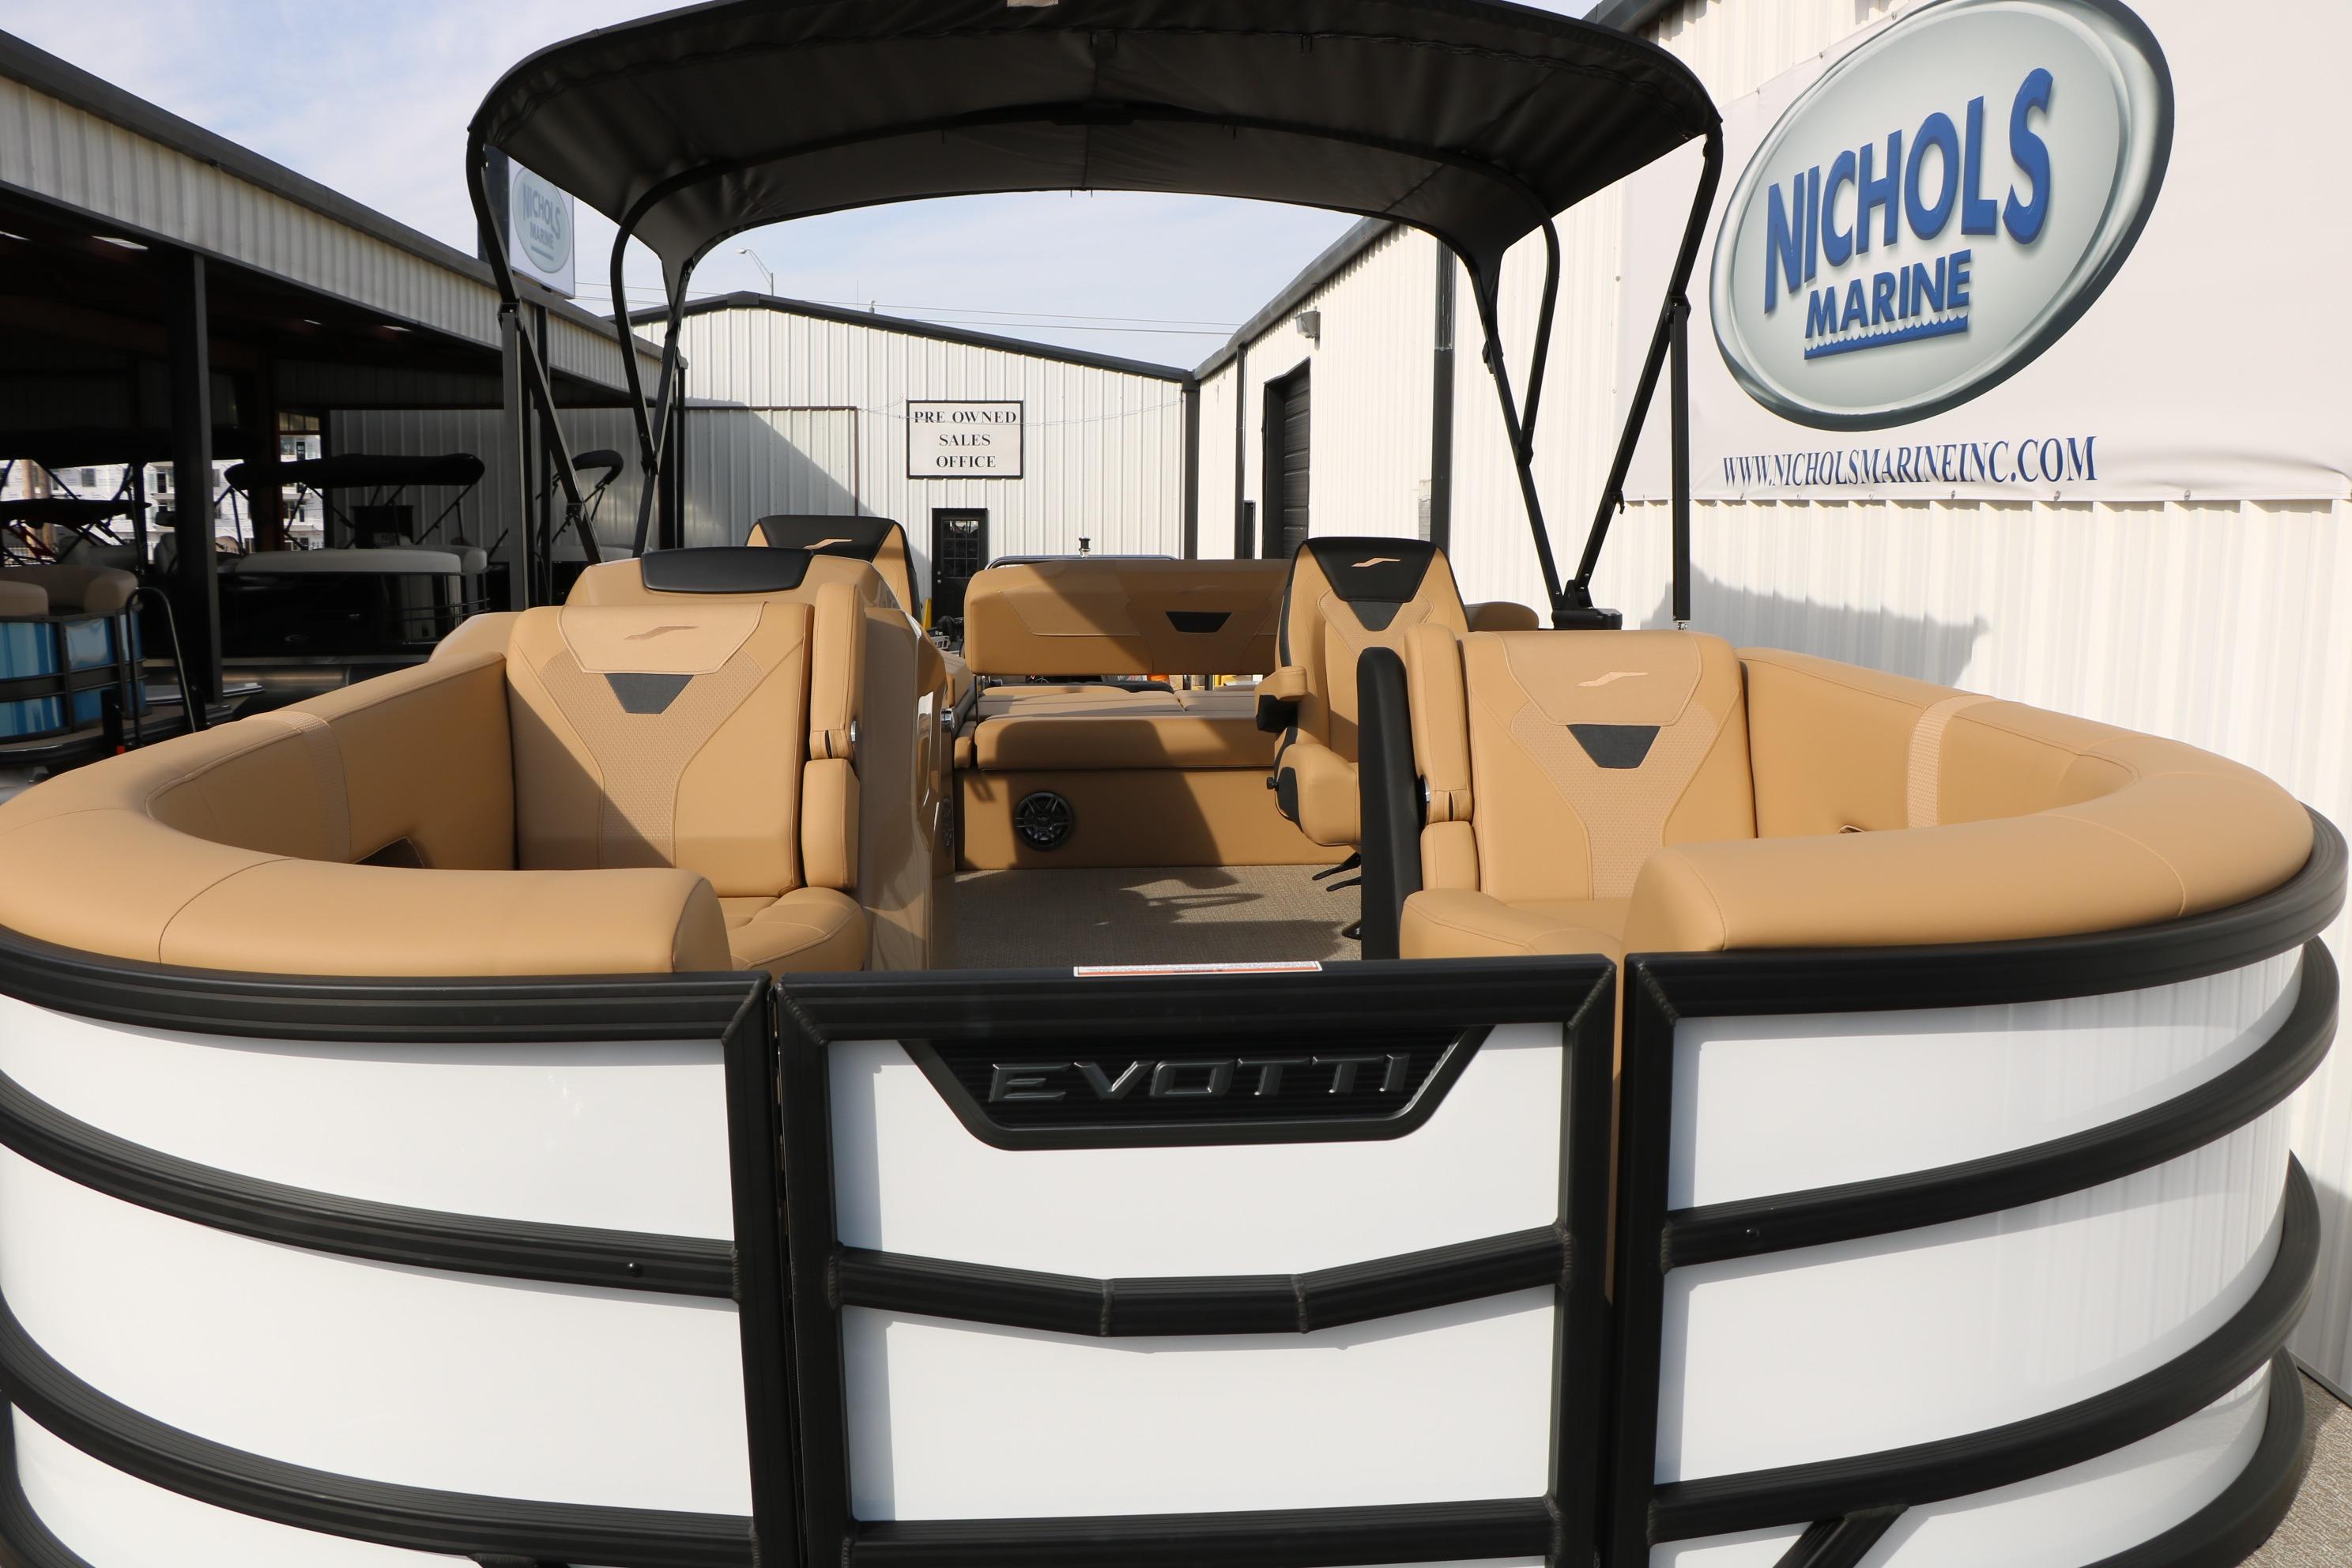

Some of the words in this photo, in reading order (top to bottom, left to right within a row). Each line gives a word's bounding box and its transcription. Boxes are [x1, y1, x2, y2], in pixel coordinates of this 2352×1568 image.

[522, 183, 561, 240] NICHOLS
[1764, 67, 2054, 315] NICHOLS
[530, 222, 554, 249] MARINE
[1804, 248, 1972, 340] MARINE
[914, 411, 945, 423] PRE
[952, 410, 1017, 424] OWNED
[939, 434, 991, 447] SALES
[936, 455, 996, 468] OFFICE
[1723, 435, 2098, 488] WWW.NICHOLSMARINEINC.COM
[987, 1053, 1411, 1102] EVOTTI
